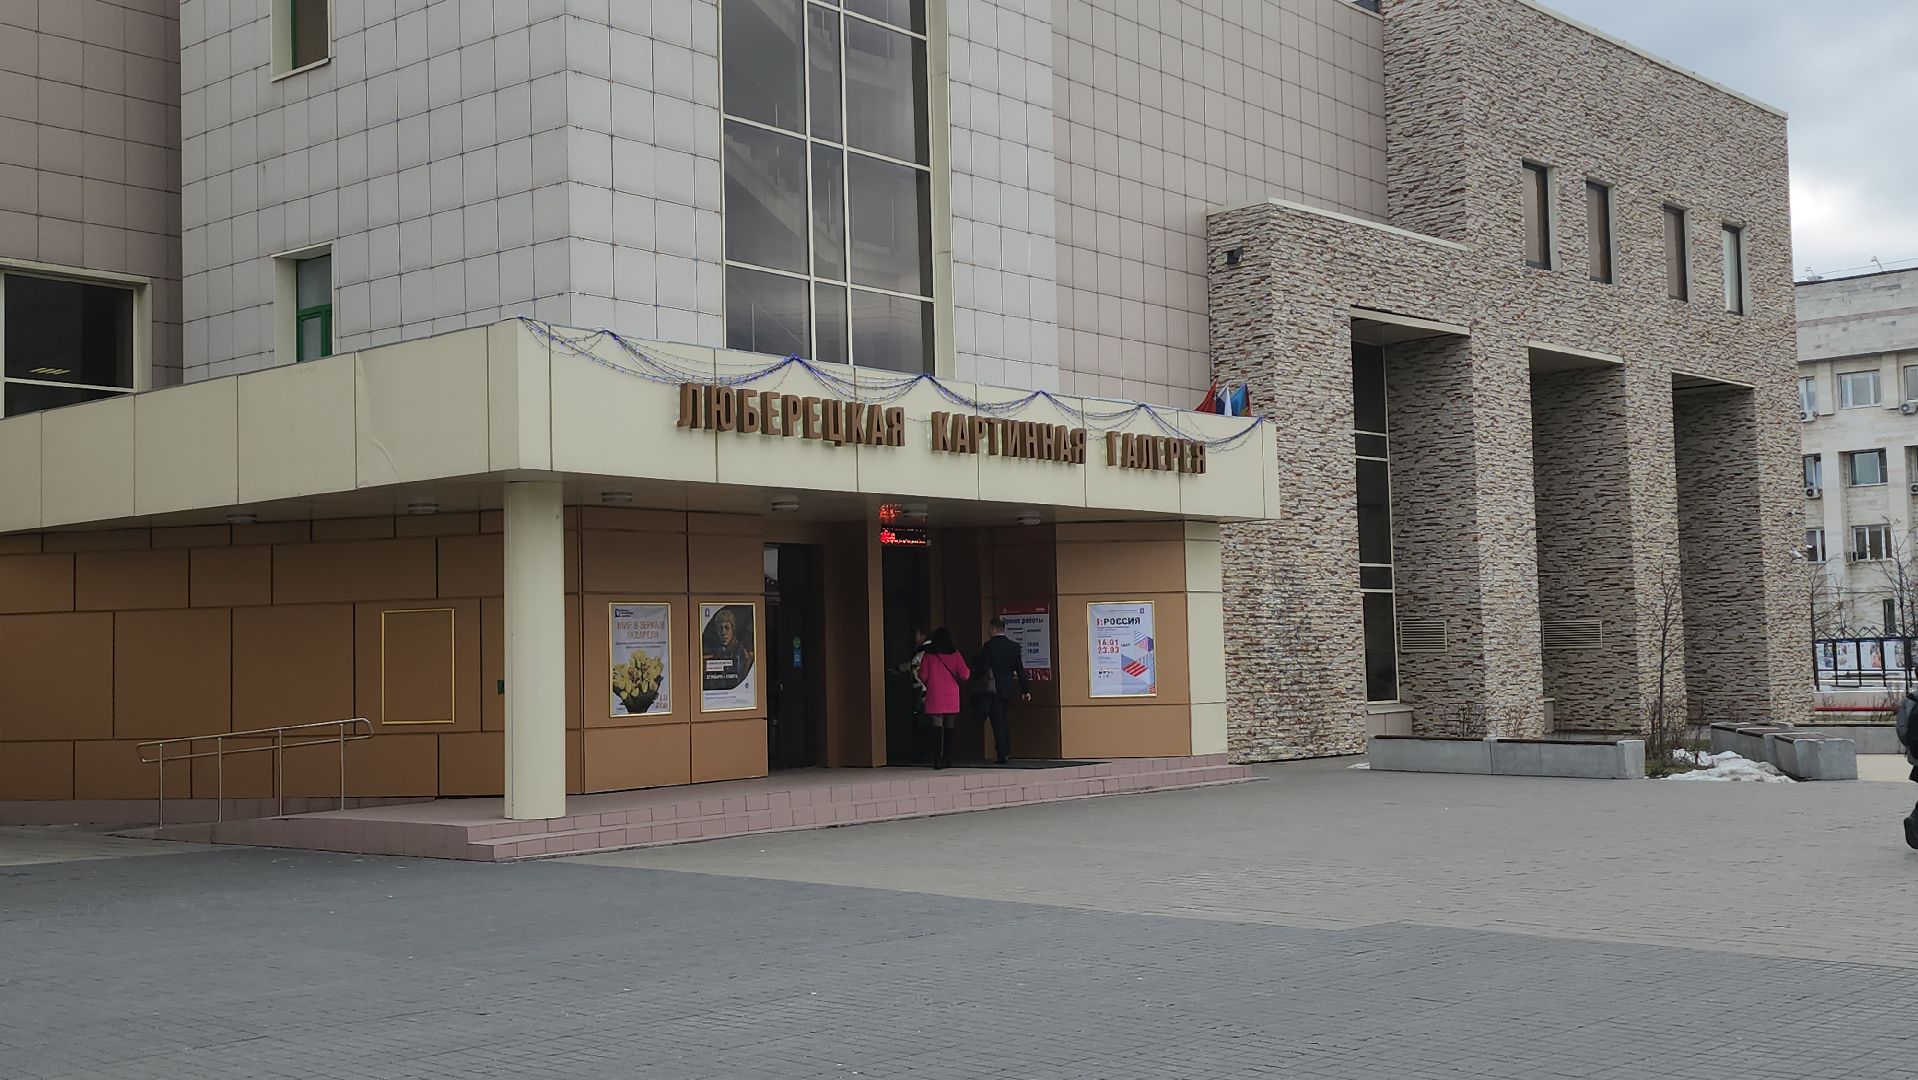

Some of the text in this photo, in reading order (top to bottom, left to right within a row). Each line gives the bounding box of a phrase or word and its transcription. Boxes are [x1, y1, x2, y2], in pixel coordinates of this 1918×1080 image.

[677, 383, 1206, 474] ЛЮБЕРЕЦКАЯ КАРТИННАЯ ГАЛЕРЕЯ
[1098, 646, 1120, 654] 23.03
